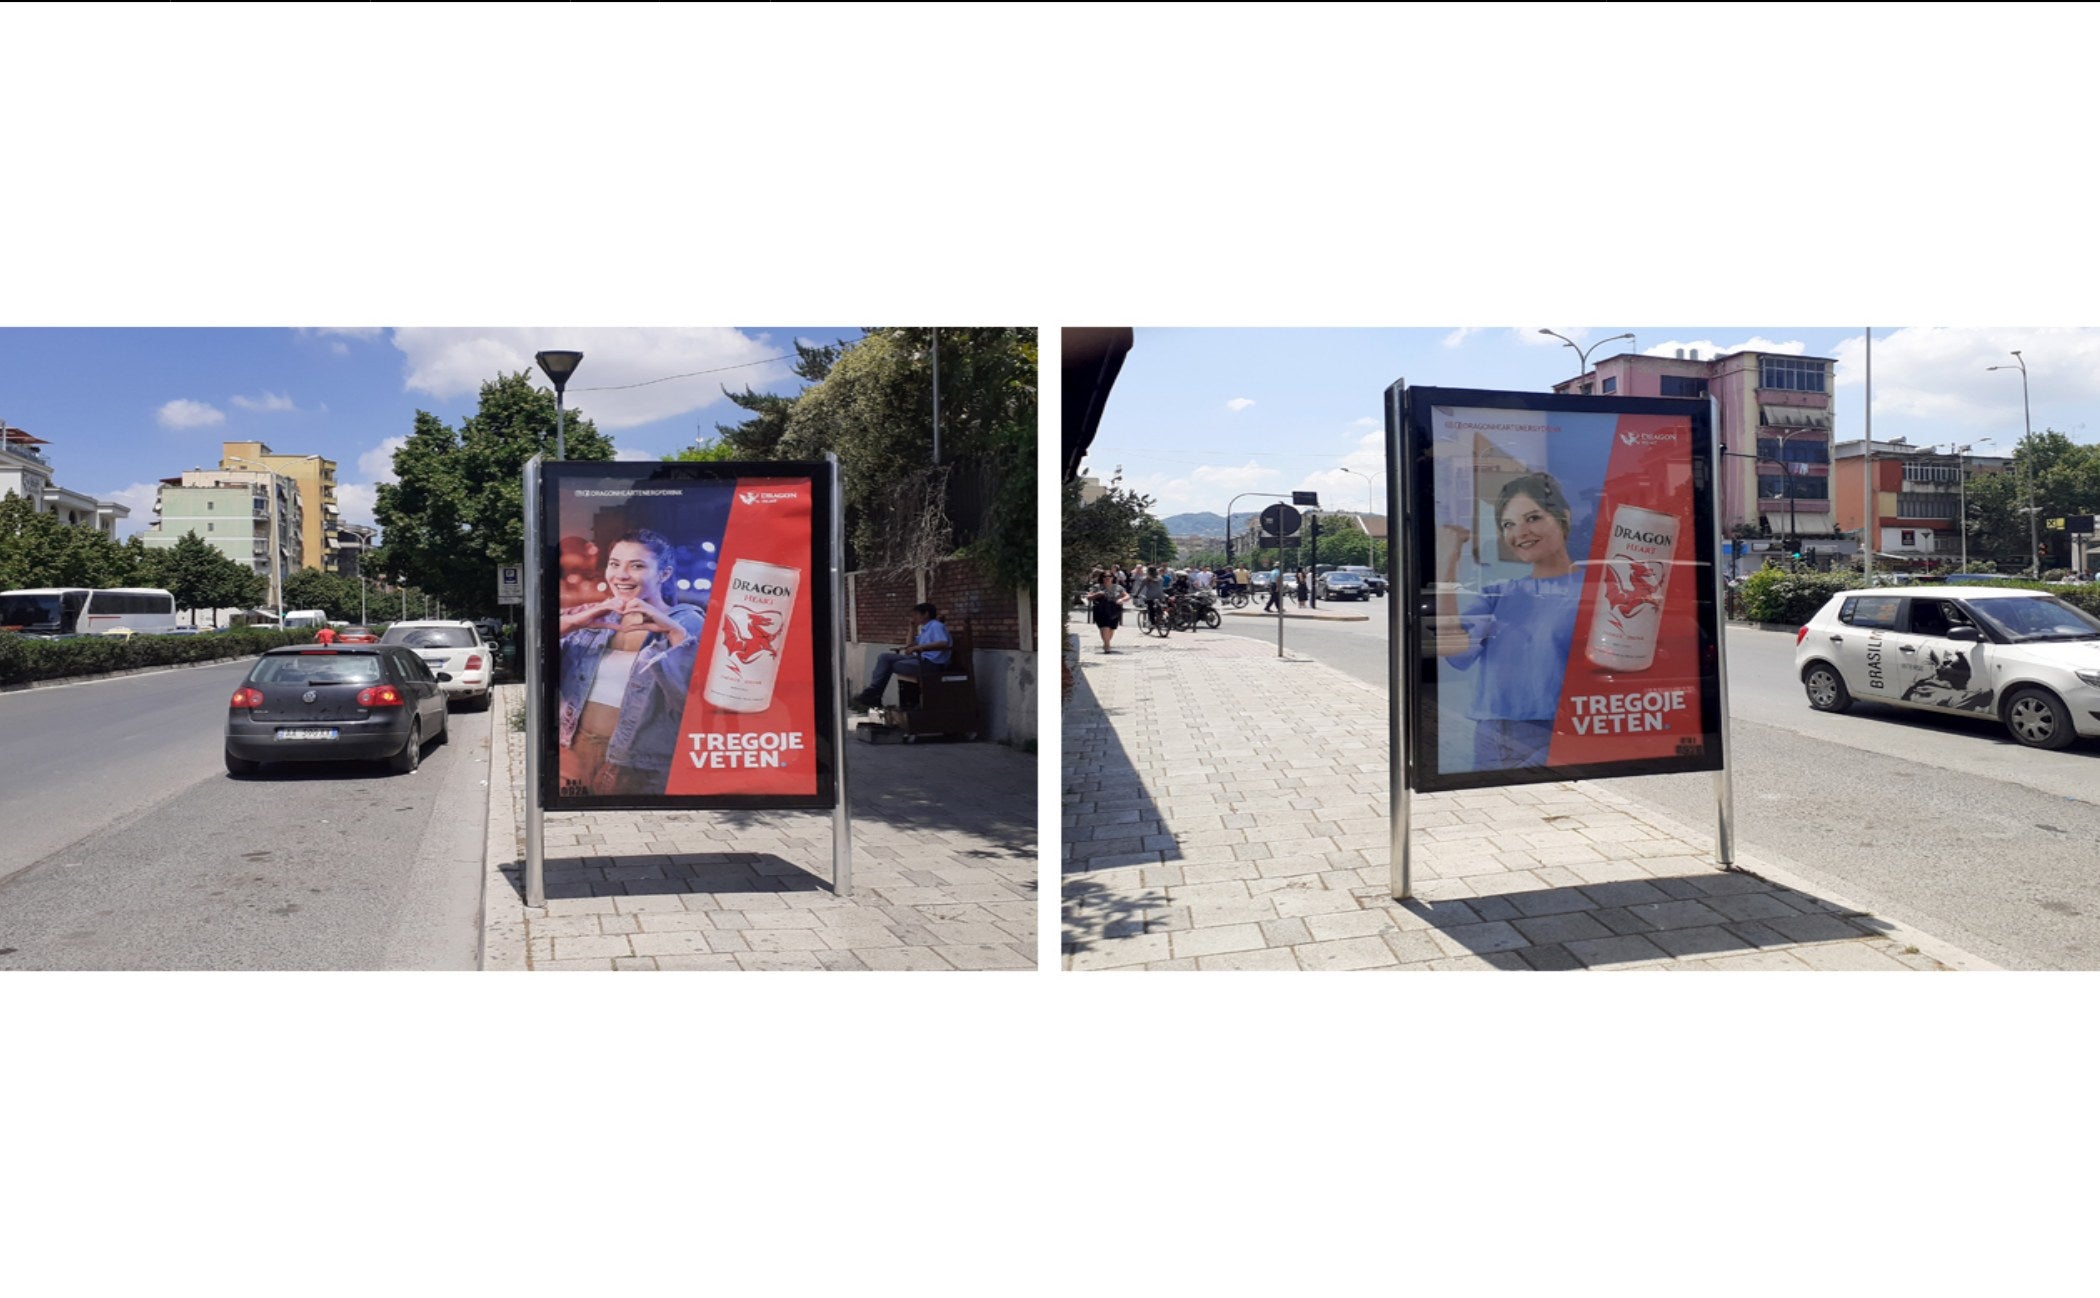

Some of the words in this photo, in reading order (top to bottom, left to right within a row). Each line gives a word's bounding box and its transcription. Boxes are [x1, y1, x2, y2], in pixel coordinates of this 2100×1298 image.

[1614, 524, 1674, 547] DRAGON
[1626, 542, 1657, 555] HEART
[732, 577, 792, 598] DRAGON
[744, 594, 775, 606] HEART
[1570, 690, 1686, 716] TREGOJE
[1571, 712, 1670, 736] VETEN.
[688, 731, 804, 751] TREGOJE
[689, 750, 787, 769] VETEN.
